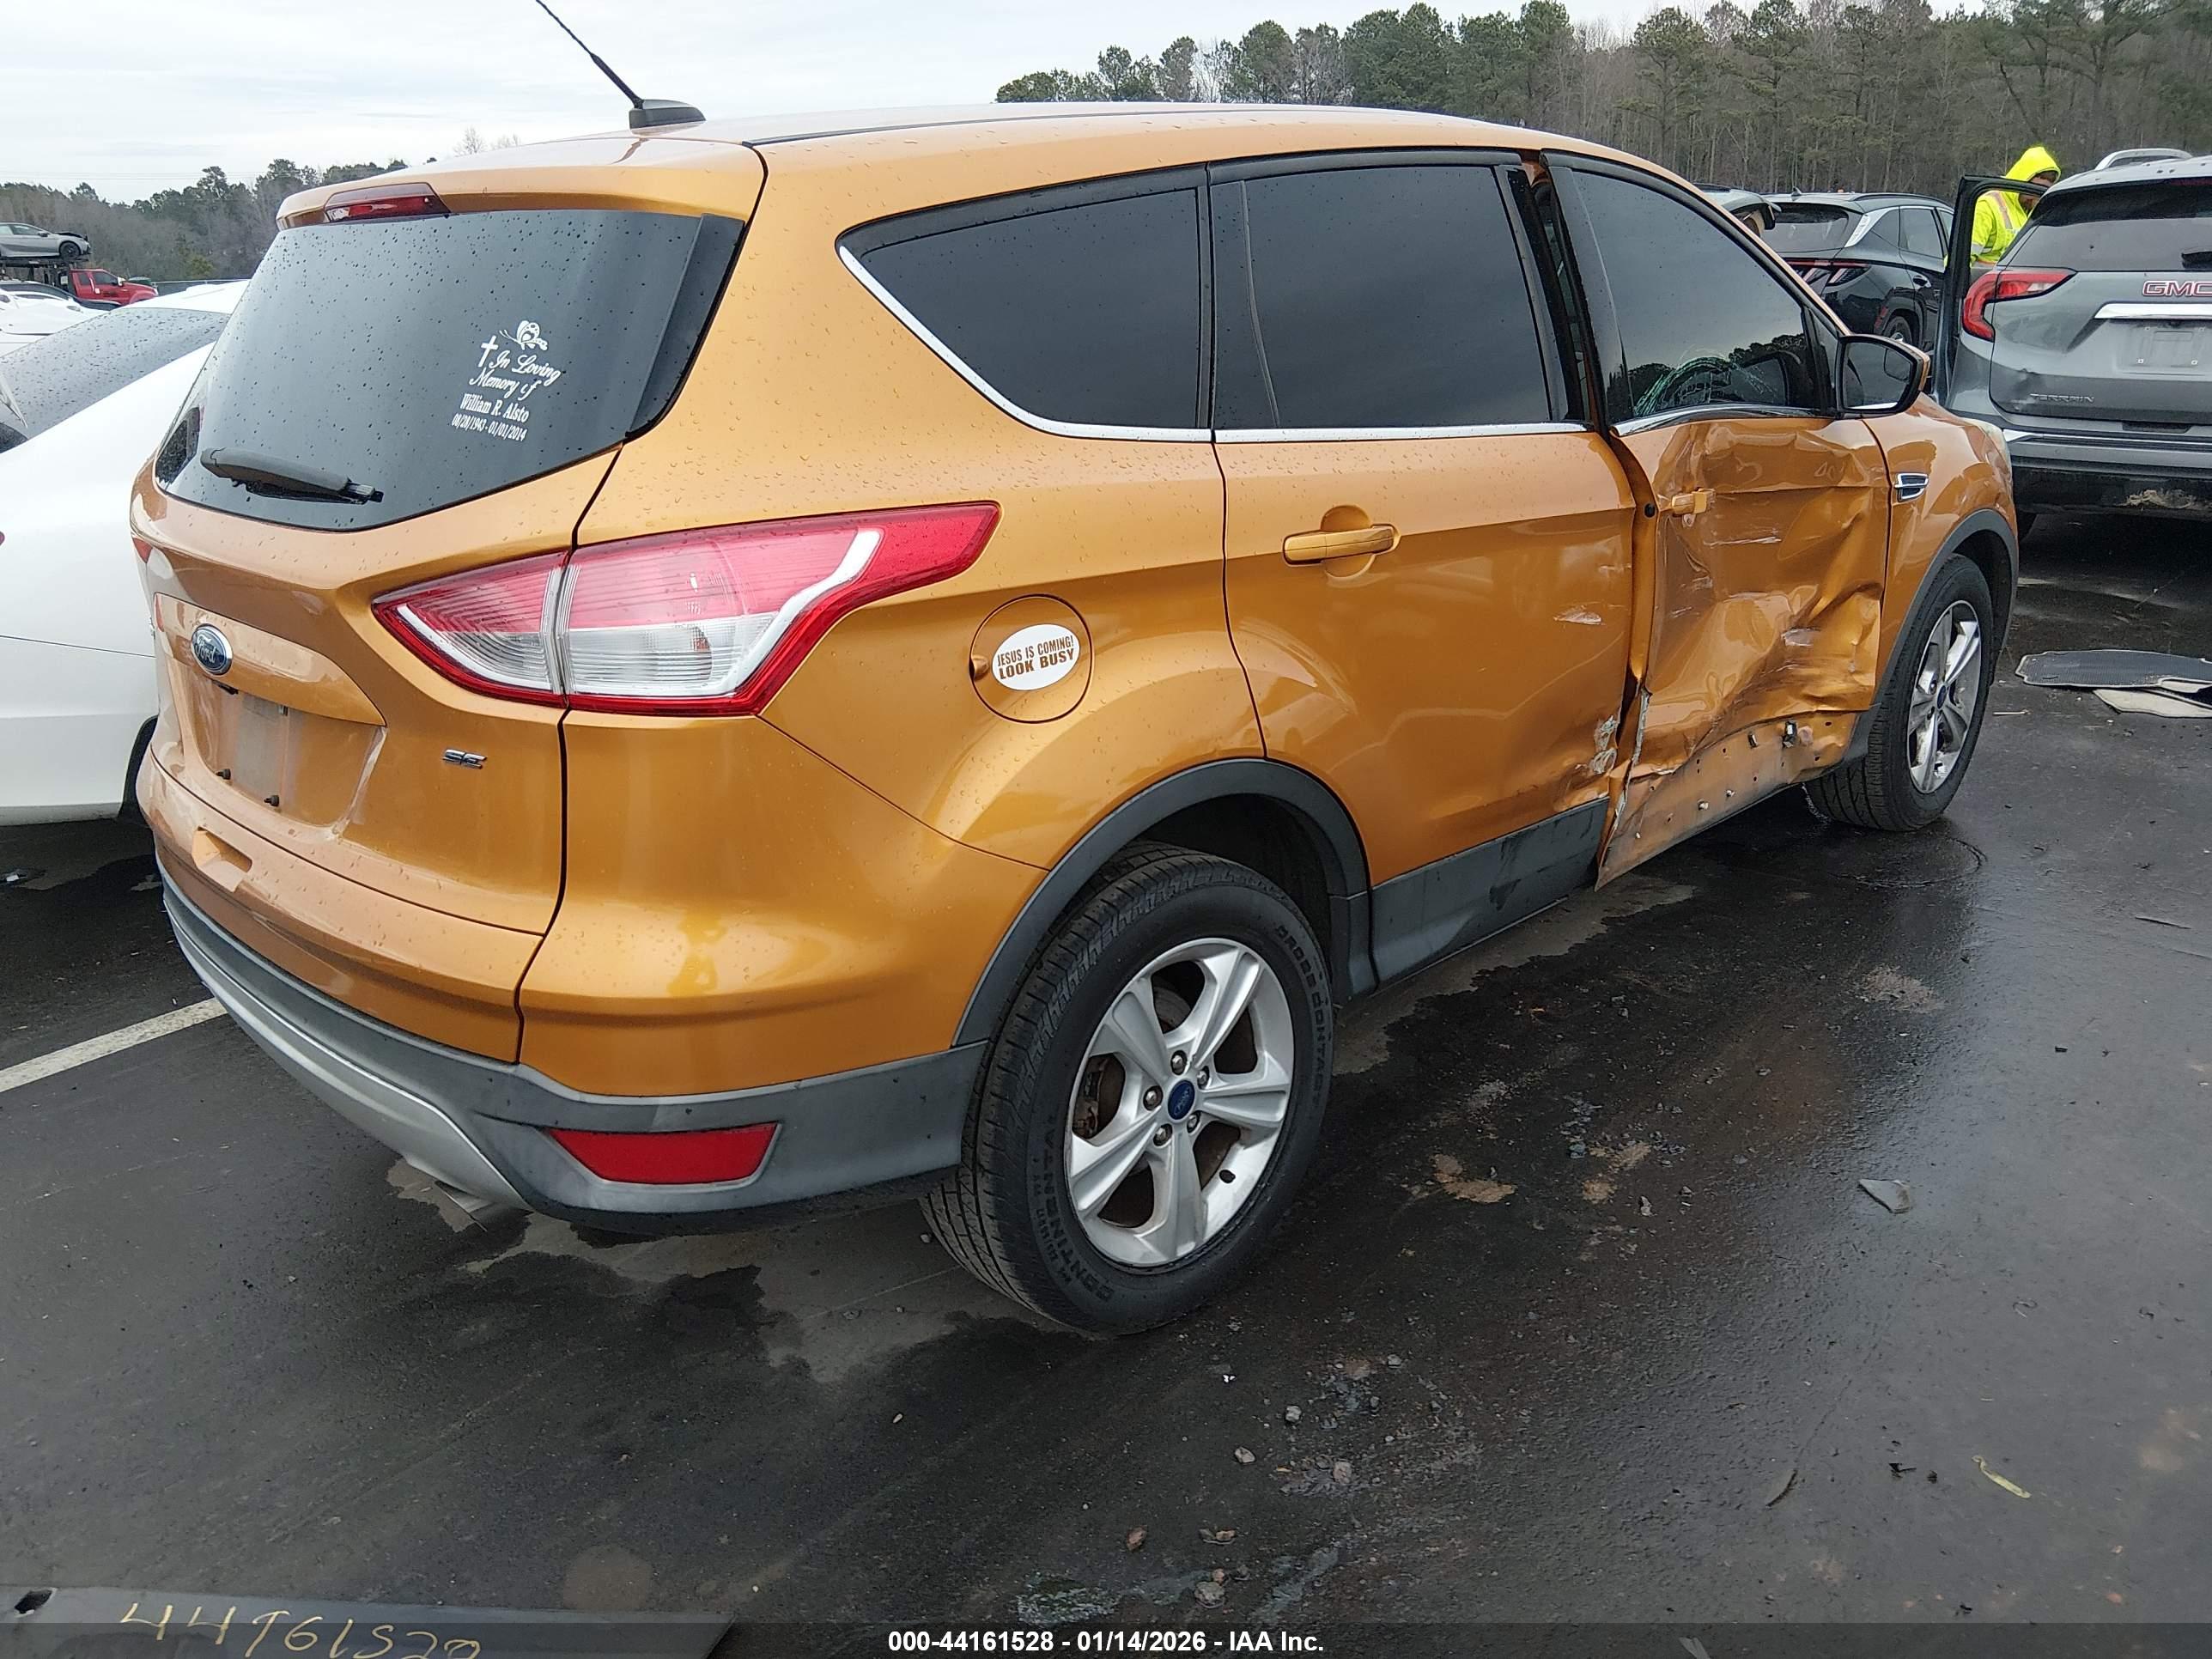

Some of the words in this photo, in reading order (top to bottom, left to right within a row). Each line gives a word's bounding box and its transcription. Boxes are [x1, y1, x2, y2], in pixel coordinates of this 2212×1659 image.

[2142, 280, 2212, 297] GMC
[489, 349, 511, 368] In
[511, 355, 561, 386] Loving
[469, 367, 520, 399] Memory
[517, 380, 542, 401] of
[2029, 393, 2094, 404] TERRAIN
[459, 392, 492, 414] William
[490, 399, 503, 416] R.
[502, 402, 530, 423] Alsto
[997, 649, 1023, 666] JESUS
[1025, 645, 1035, 659] IS
[1036, 635, 1074, 656] COMING!
[999, 659, 1036, 680] LOOK
[1039, 648, 1074, 669] BUSY
[442, 748, 487, 769] SE
